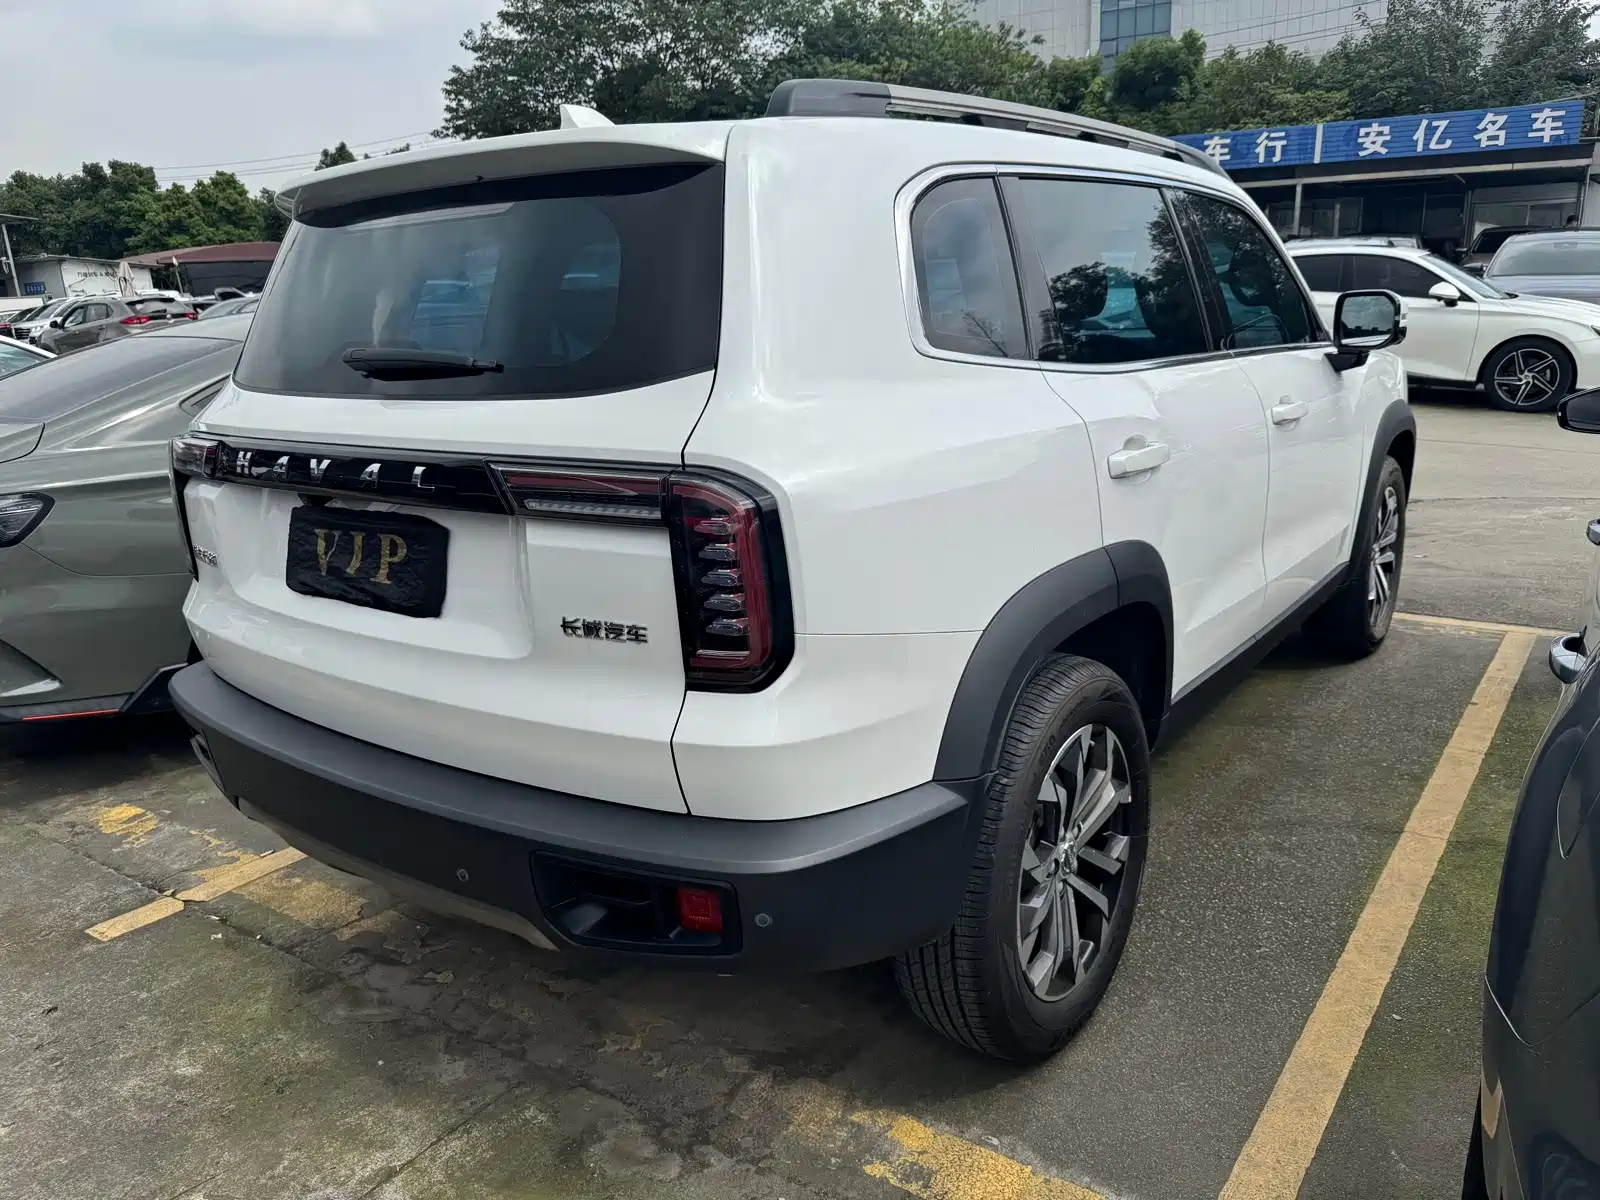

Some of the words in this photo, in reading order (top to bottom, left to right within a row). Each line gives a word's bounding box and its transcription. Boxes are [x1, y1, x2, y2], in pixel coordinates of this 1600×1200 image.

[1203, 131, 1288, 165] 车行
[1357, 107, 1566, 158] 安亿名车
[236, 451, 435, 493] HAVAL
[314, 527, 408, 585] VIP
[560, 616, 649, 645] 长城汽车
